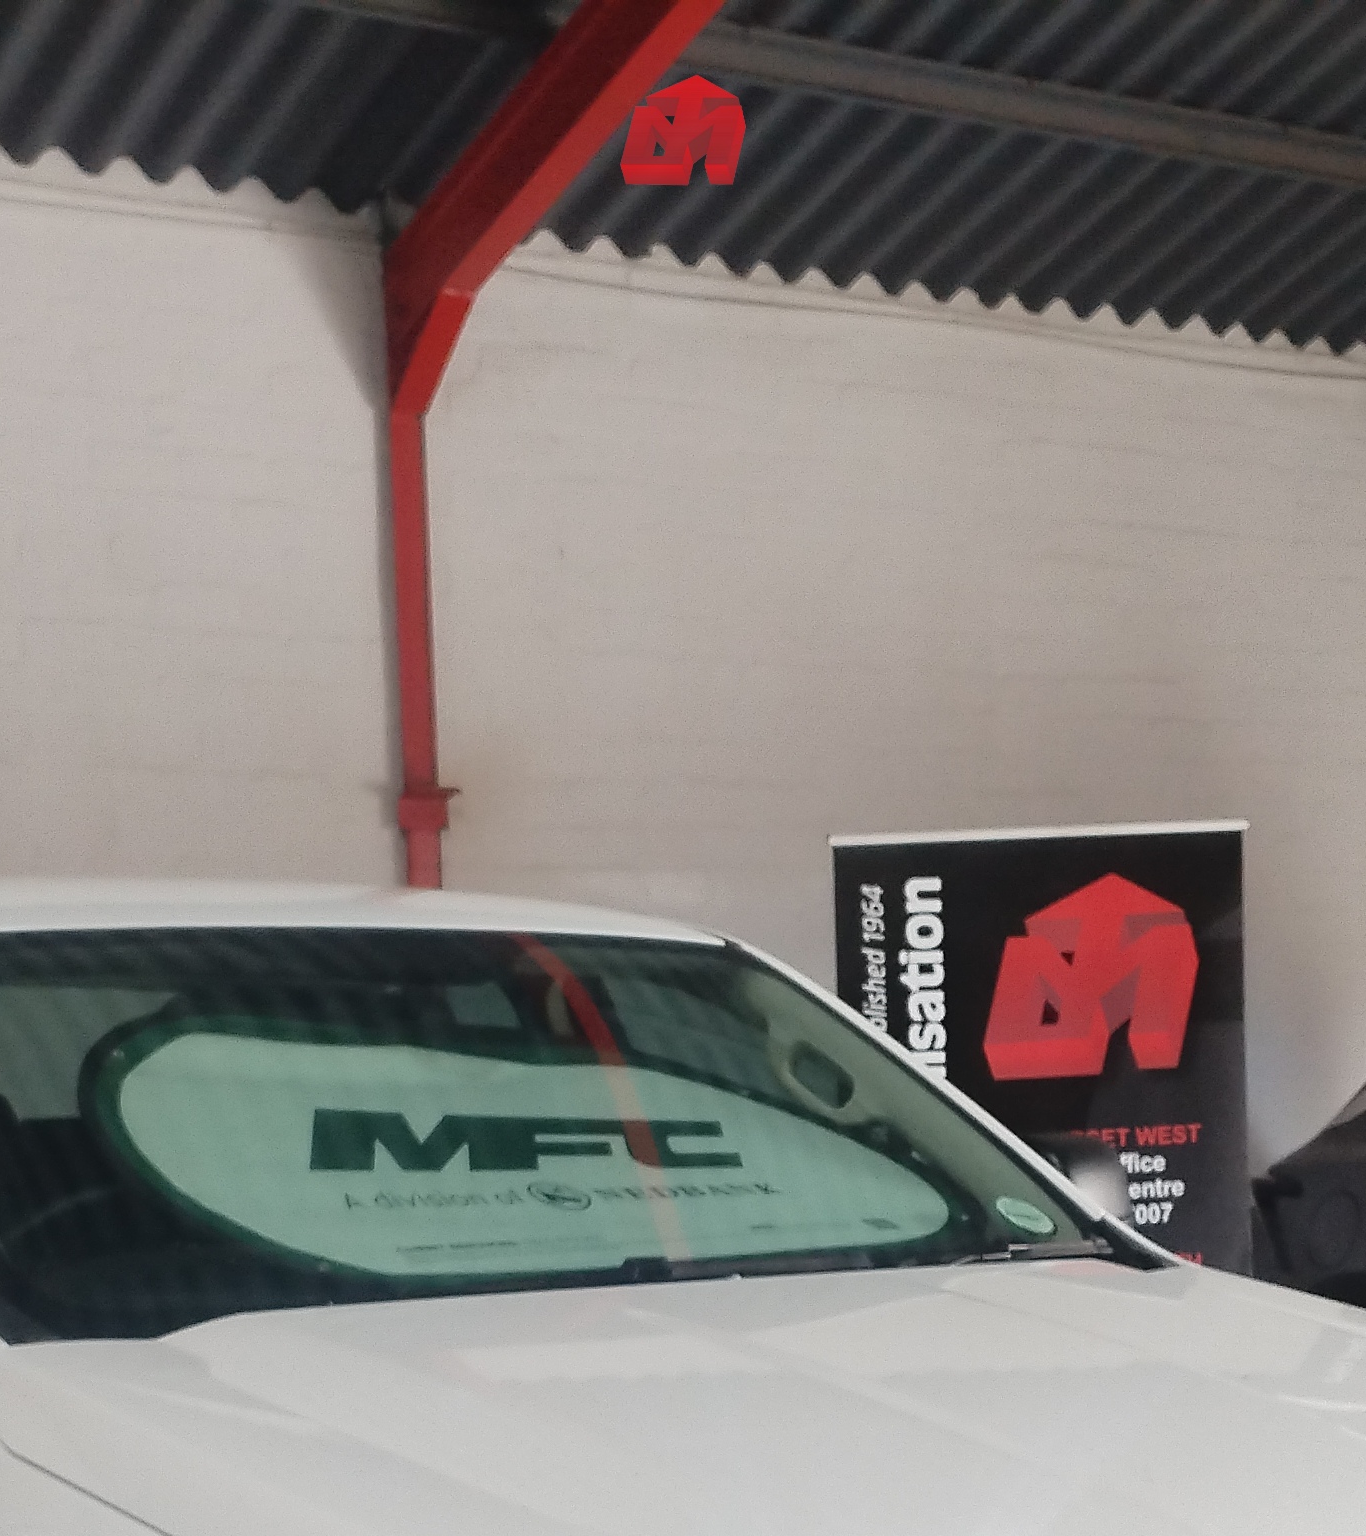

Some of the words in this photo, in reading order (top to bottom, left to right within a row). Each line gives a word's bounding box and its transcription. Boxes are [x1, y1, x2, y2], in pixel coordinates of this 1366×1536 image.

[860, 883, 885, 943] 1964
[898, 876, 947, 1079] isation
[309, 1107, 743, 1172] MFC
[1136, 1122, 1202, 1146] WEST
[1128, 1178, 1186, 1200] entre
[1133, 1201, 1174, 1225] 007
